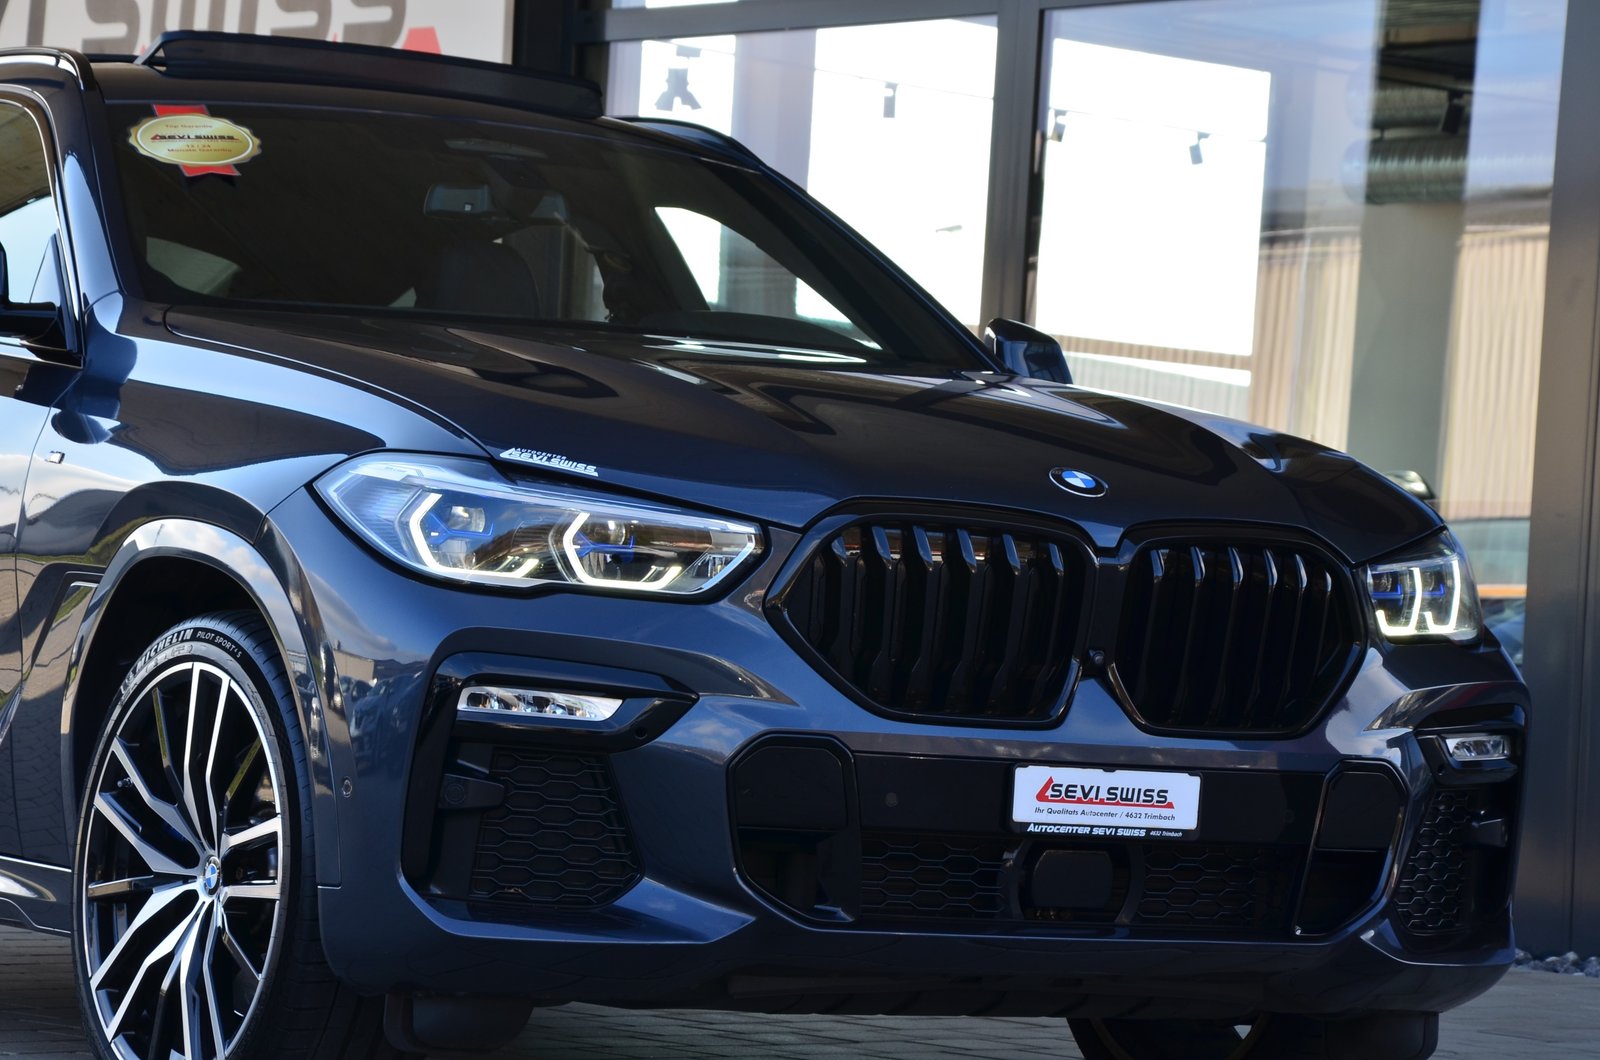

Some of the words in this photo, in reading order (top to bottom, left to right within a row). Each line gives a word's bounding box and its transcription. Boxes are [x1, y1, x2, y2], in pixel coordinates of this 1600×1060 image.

[509, 451, 549, 464] SEVI
[549, 458, 597, 473] SWISS
[516, 448, 567, 460] AUTOCENTER
[135, 628, 194, 672] MICHELIN
[196, 630, 215, 641] PILOT
[214, 635, 236, 652] SPORT
[1049, 783, 1101, 801] SEVI
[1106, 786, 1169, 804] SWISS
[1034, 806, 1045, 814] Ihr
[1080, 809, 1118, 818] Autocenter
[1125, 811, 1143, 819] 4632
[1144, 812, 1176, 821] Trimbach
[1092, 827, 1116, 836] SEVI
[1116, 828, 1147, 837] SWISS
